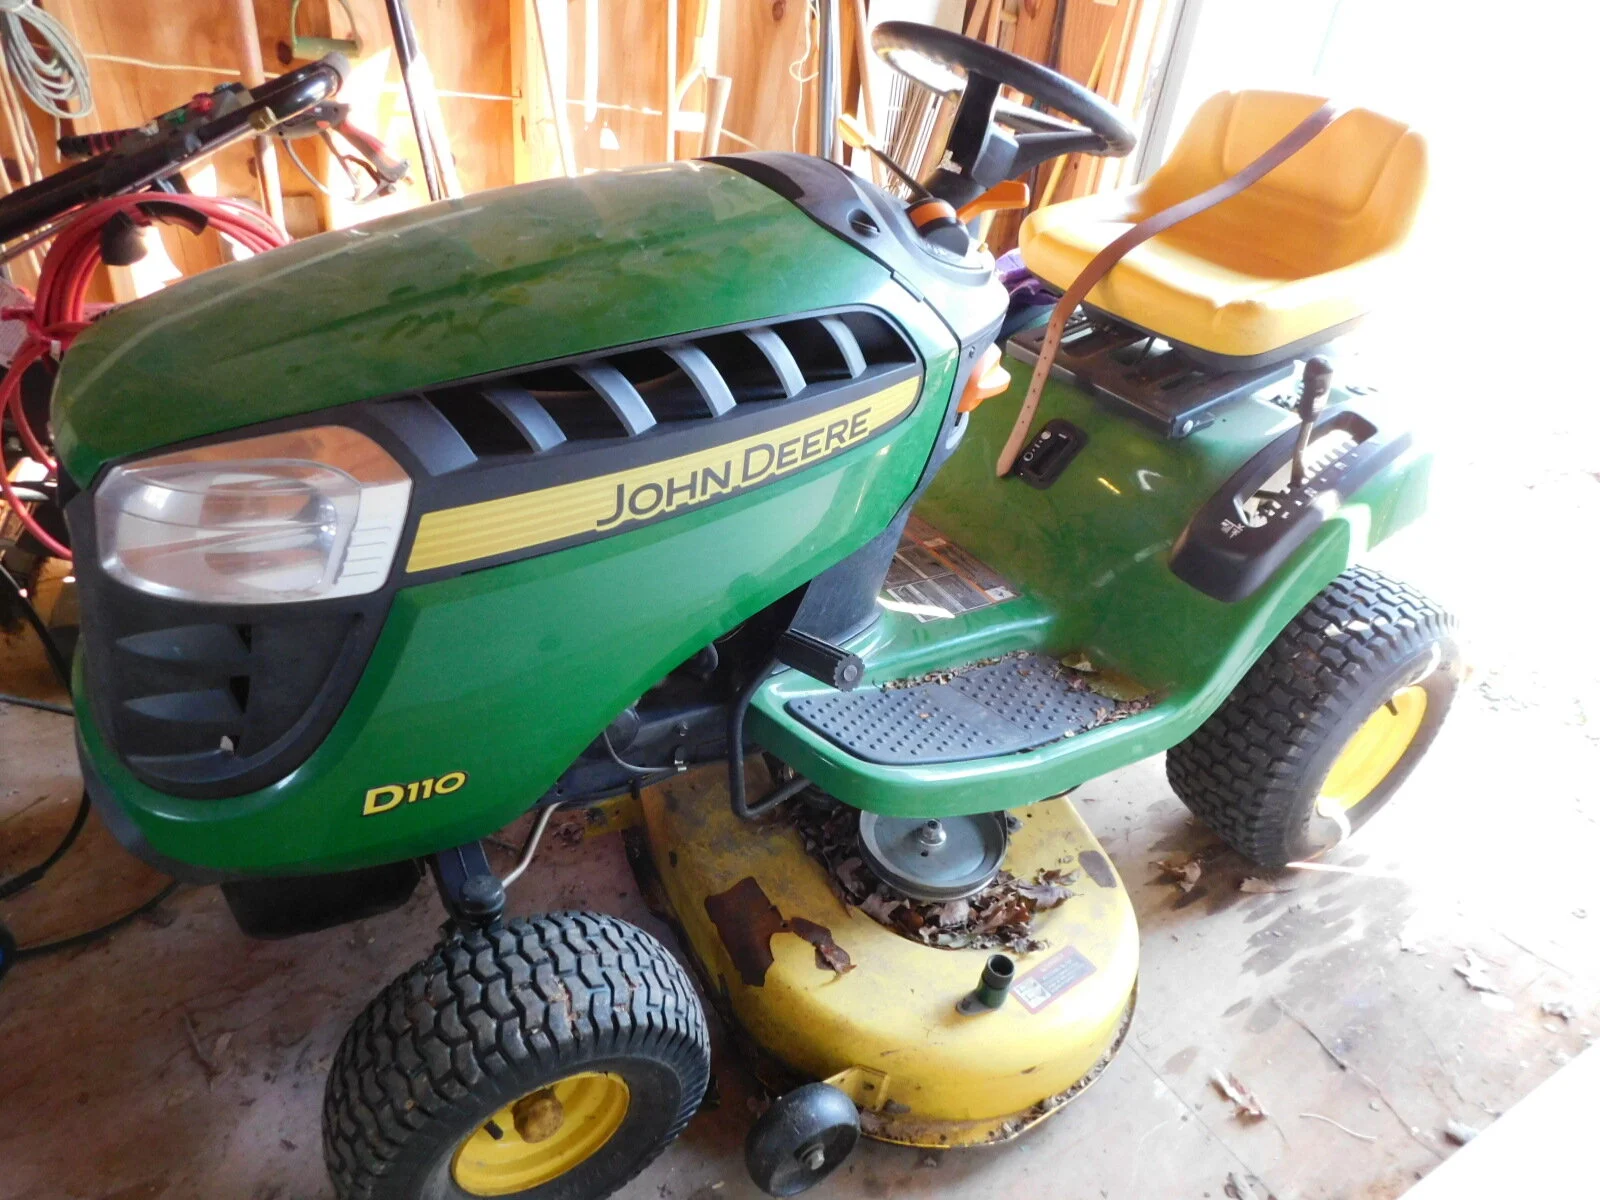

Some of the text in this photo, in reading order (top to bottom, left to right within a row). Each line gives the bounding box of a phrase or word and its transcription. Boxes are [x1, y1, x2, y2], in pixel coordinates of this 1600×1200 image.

[596, 407, 872, 527] JOHN DEERE
[362, 771, 467, 816] D110
